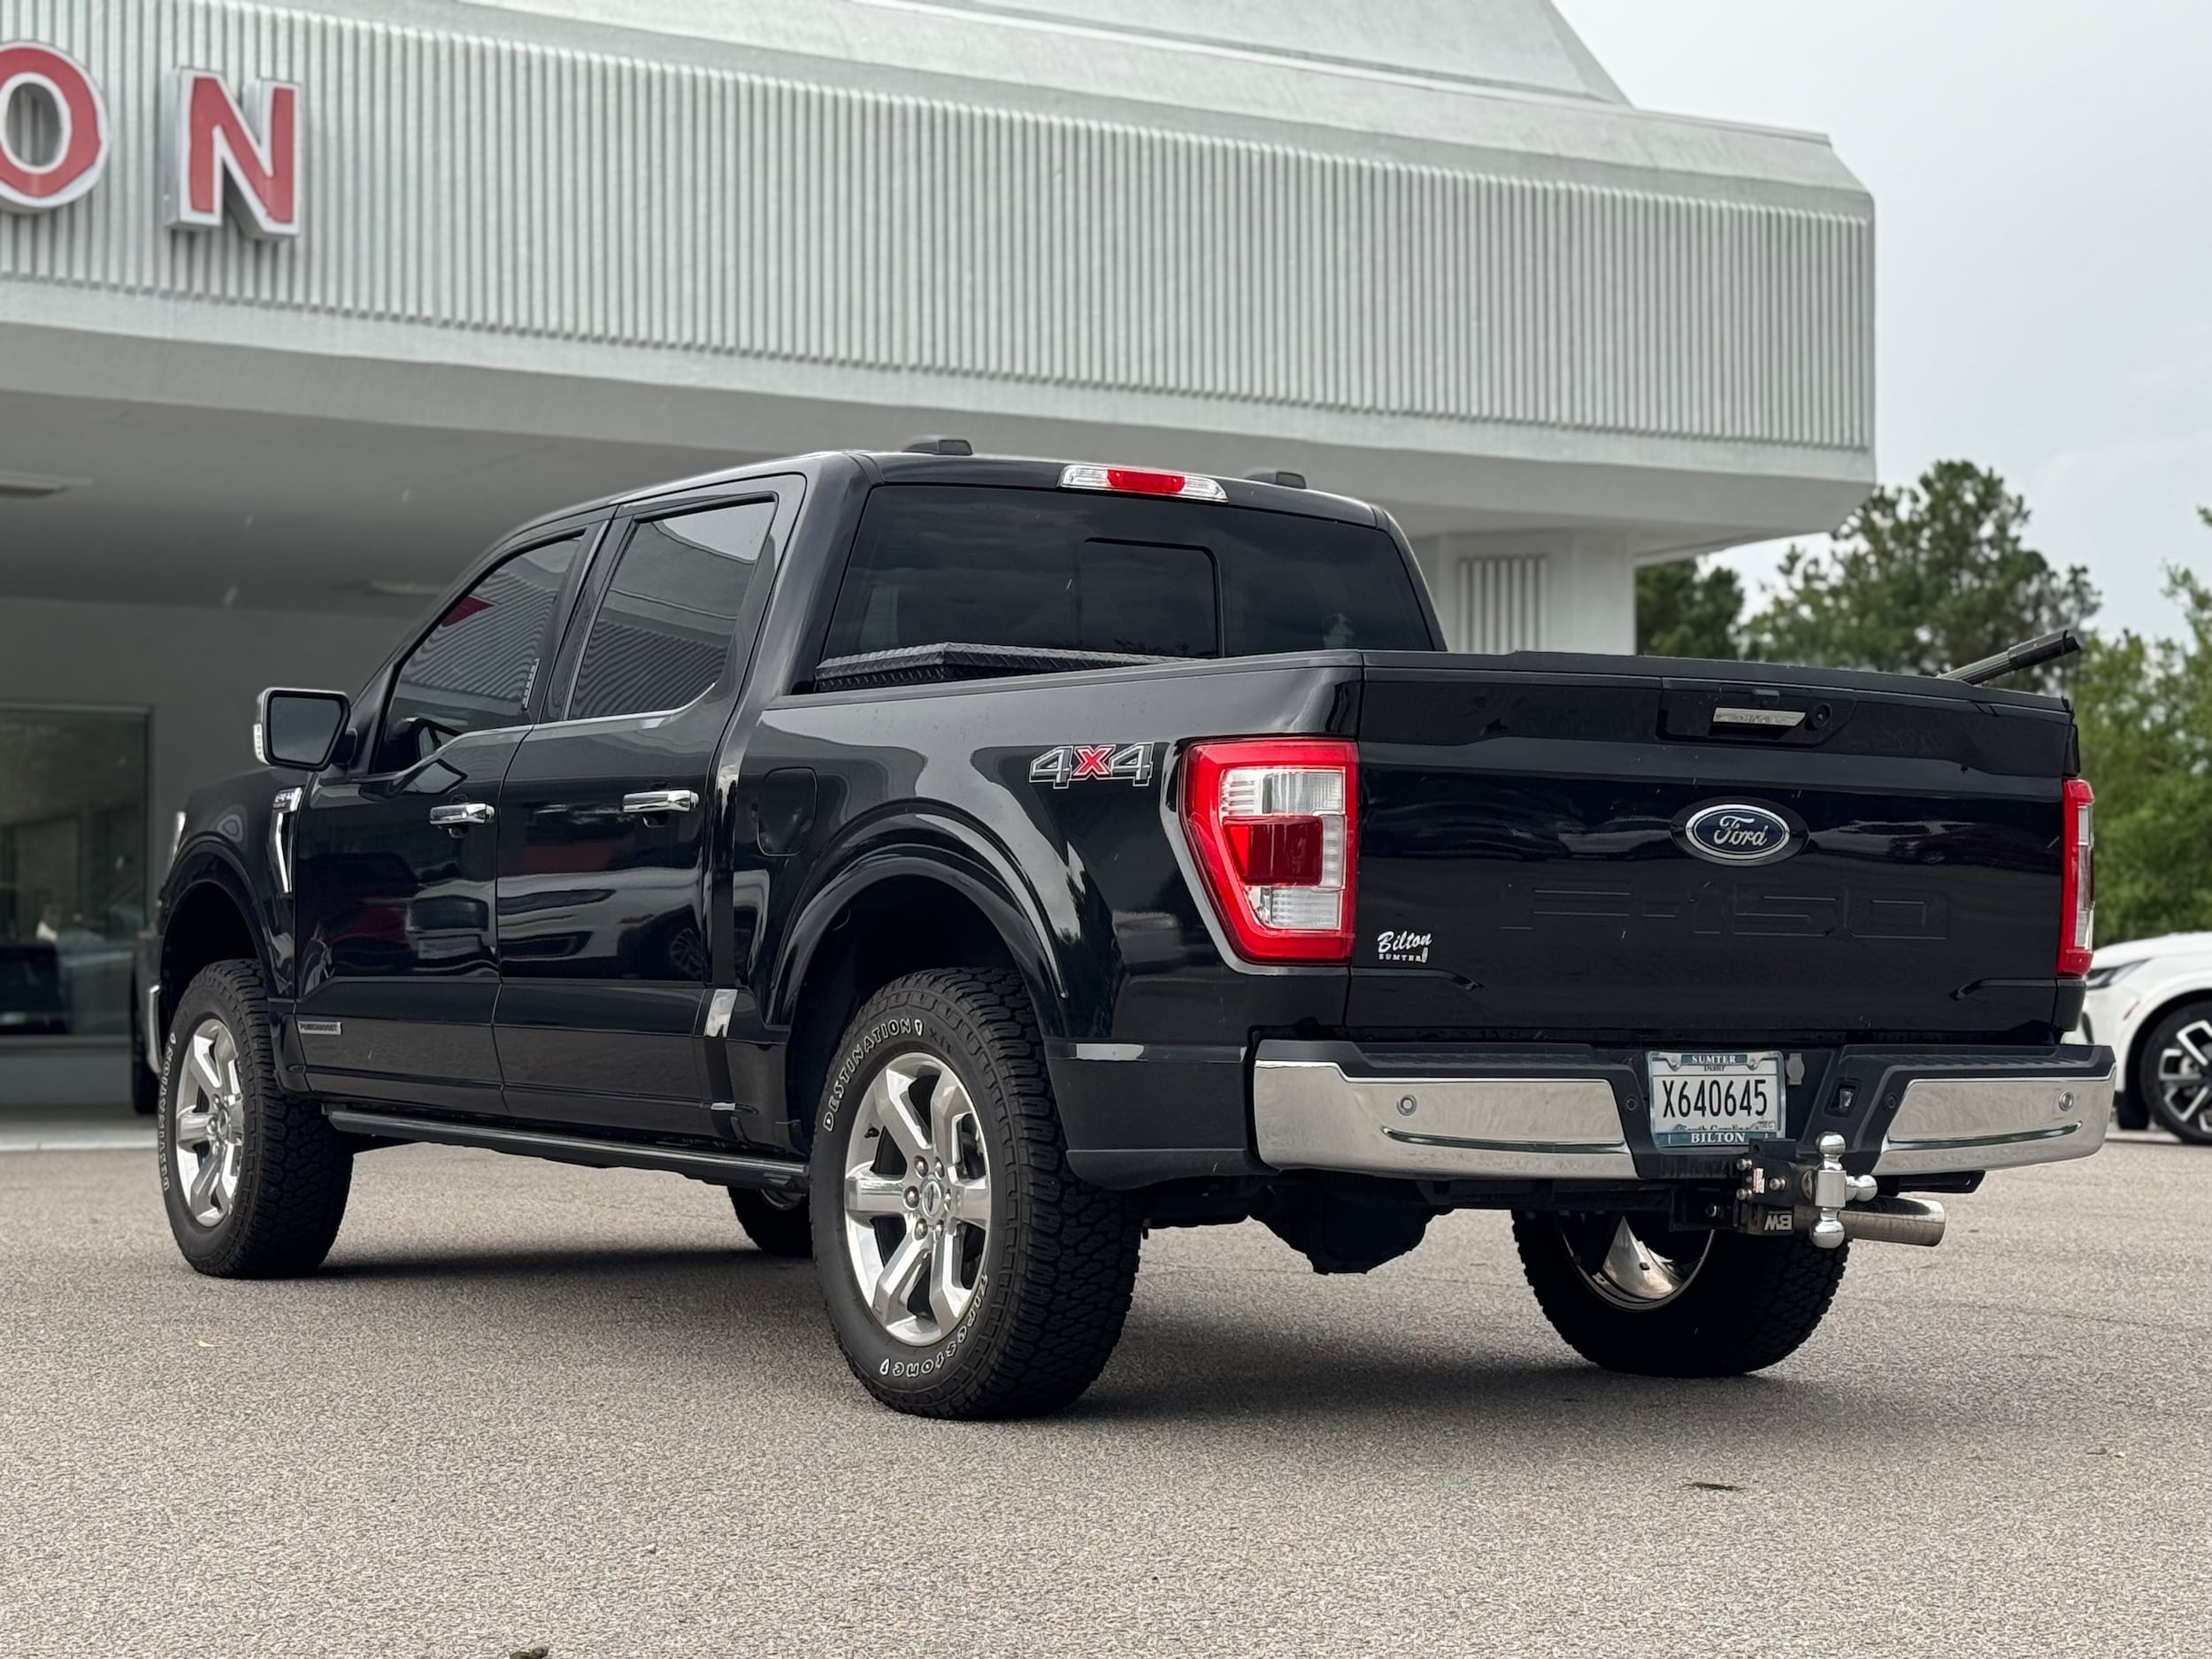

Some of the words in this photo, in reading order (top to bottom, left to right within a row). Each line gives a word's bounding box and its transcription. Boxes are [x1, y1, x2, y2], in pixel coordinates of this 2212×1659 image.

[0, 41, 301, 239] ON
[1713, 815, 1771, 847] Ford
[1378, 931, 1432, 953] Bilton
[1379, 954, 1423, 963] SUMTER
[1692, 1055, 1737, 1064] SUMTER
[823, 1018, 912, 1133] DESTINATION
[1662, 1079, 1768, 1118] X640645
[1691, 1132, 1746, 1143] BILTON
